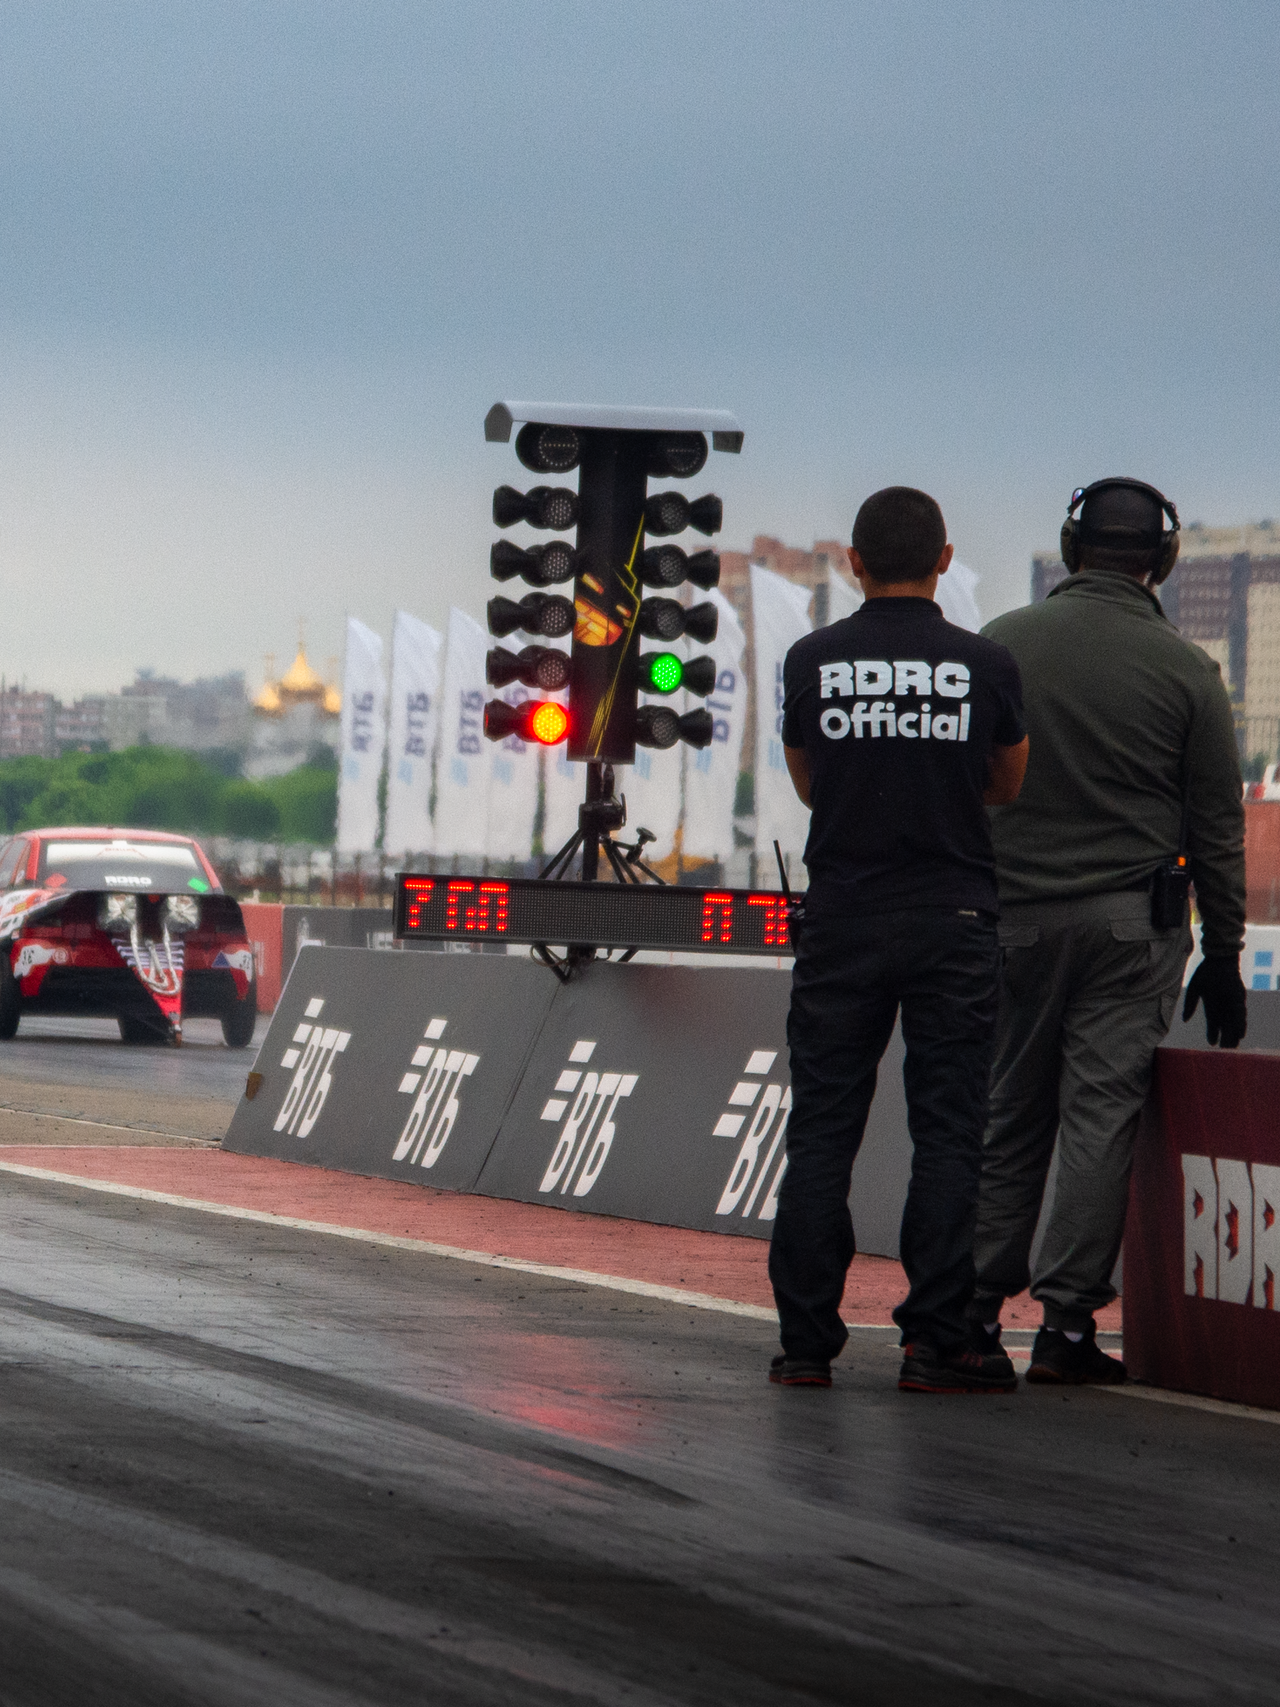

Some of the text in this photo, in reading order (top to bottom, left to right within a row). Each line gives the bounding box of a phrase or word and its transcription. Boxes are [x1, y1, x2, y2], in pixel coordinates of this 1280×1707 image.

[819, 660, 970, 699] RDRC
[820, 702, 970, 741] Official
[273, 1027, 351, 1139] ВТБ
[393, 1049, 480, 1169] ВТБ
[538, 1072, 639, 1197] ВТБ
